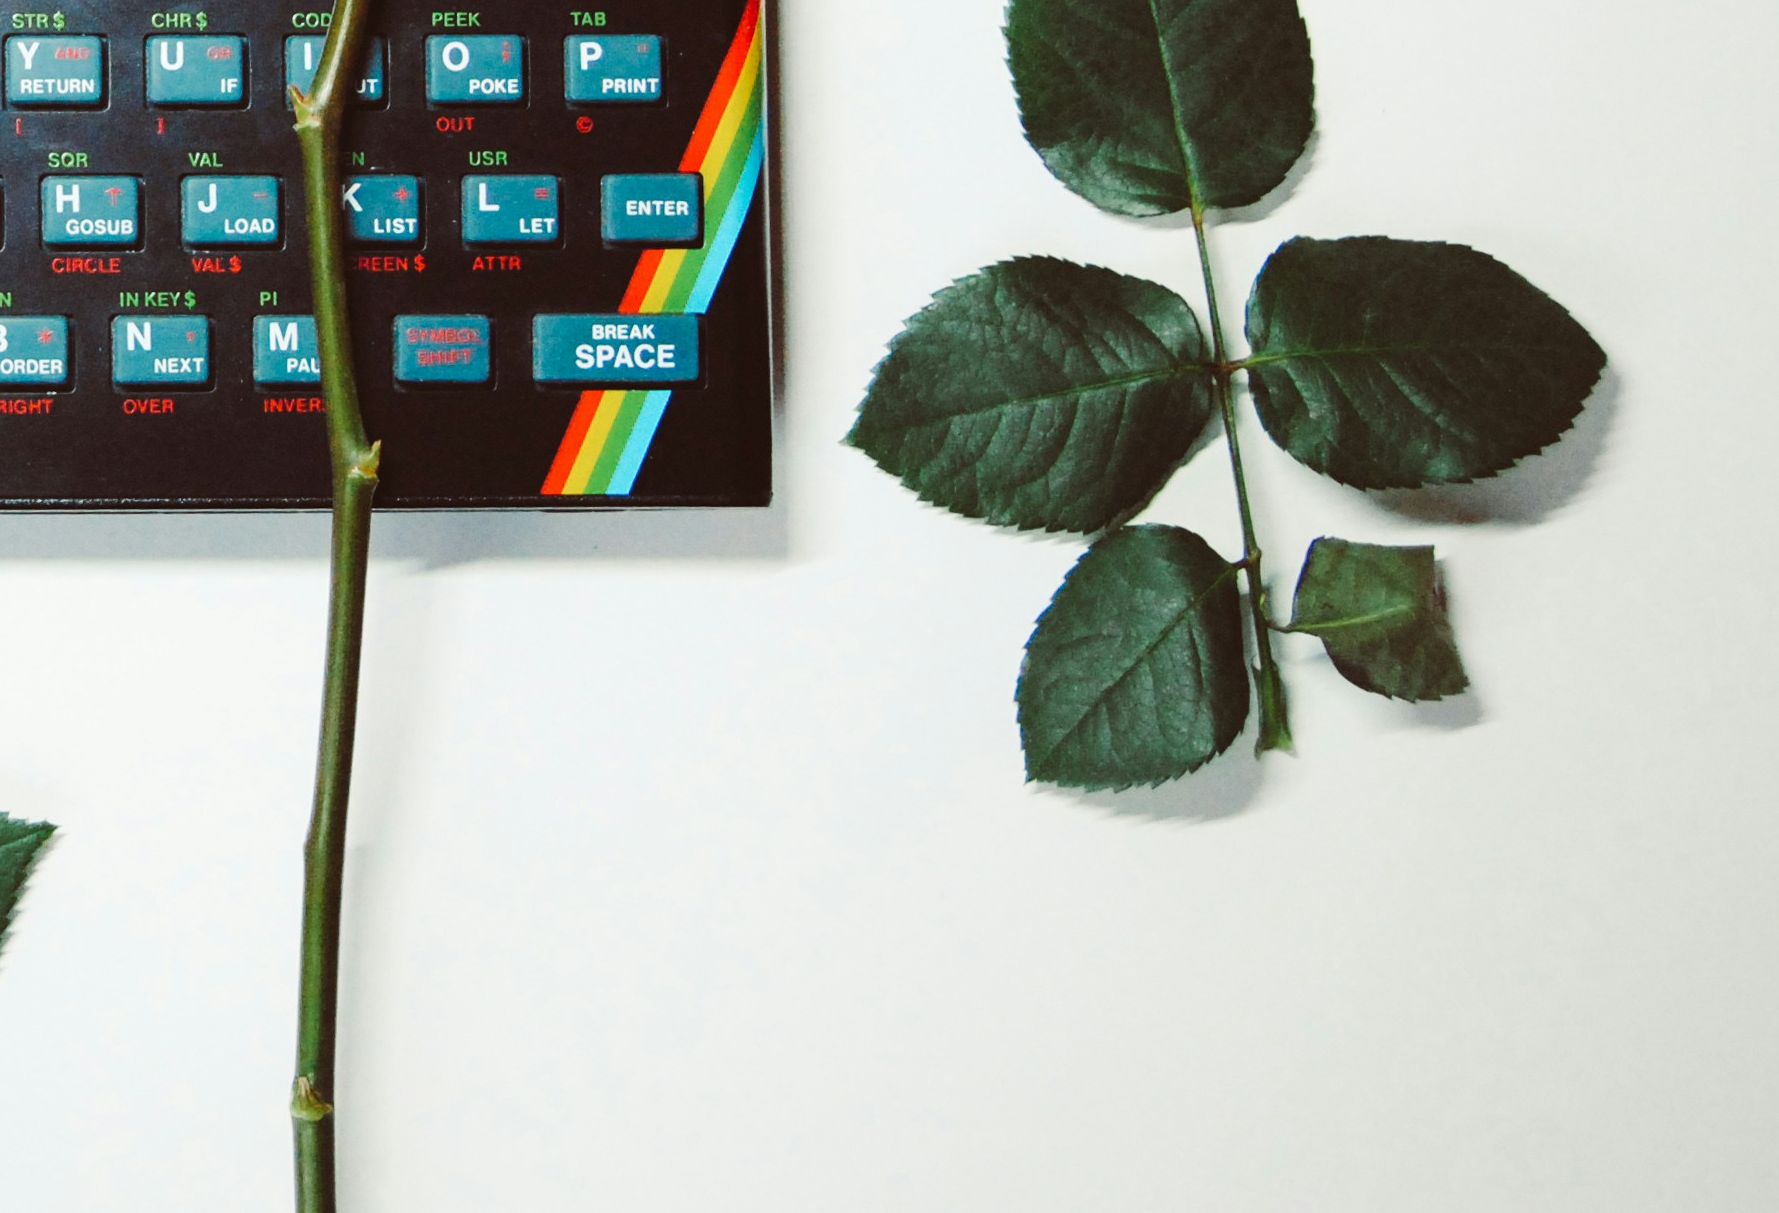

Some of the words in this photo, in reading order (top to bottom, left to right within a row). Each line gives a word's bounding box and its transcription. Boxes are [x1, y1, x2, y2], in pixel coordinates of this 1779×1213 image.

[292, 13, 332, 28] COD
[432, 12, 480, 27] PEEK
[571, 12, 606, 26] TAB
[17, 42, 39, 70] Y
[160, 42, 184, 70] U
[304, 42, 312, 70] I
[442, 42, 469, 71] O
[580, 42, 603, 70] P
[21, 79, 94, 93] RETURN
[221, 79, 237, 93] IF
[469, 79, 518, 93] POKE
[602, 78, 659, 93] PRINT
[437, 117, 475, 132] OUT
[48, 153, 88, 168] SQR
[188, 152, 223, 167] VAL
[469, 151, 508, 165] USR
[55, 185, 79, 213] H
[198, 184, 217, 213] J
[343, 183, 363, 212] K
[479, 183, 500, 211] L
[626, 201, 689, 216] ENTER
[66, 219, 133, 234] GOSUB
[224, 219, 275, 233] LOAD
[374, 219, 416, 233] LIST
[520, 218, 555, 232] LET
[52, 258, 119, 273] CIRCLE
[192, 258, 229, 272] VAL
[357, 257, 407, 271] REEN
[414, 254, 426, 273] $
[472, 257, 520, 271] ATTR
[260, 292, 277, 306] PI
[126, 323, 151, 351] N
[269, 322, 297, 350] M
[406, 329, 481, 344] SYMBOL
[592, 325, 655, 340] BREAK
[417, 350, 473, 365] SHIFT
[575, 344, 675, 369] SPACE
[154, 358, 204, 373] NEXT
[287, 357, 319, 373] PAU
[123, 399, 174, 414] OVER
[264, 399, 328, 413] INVER
